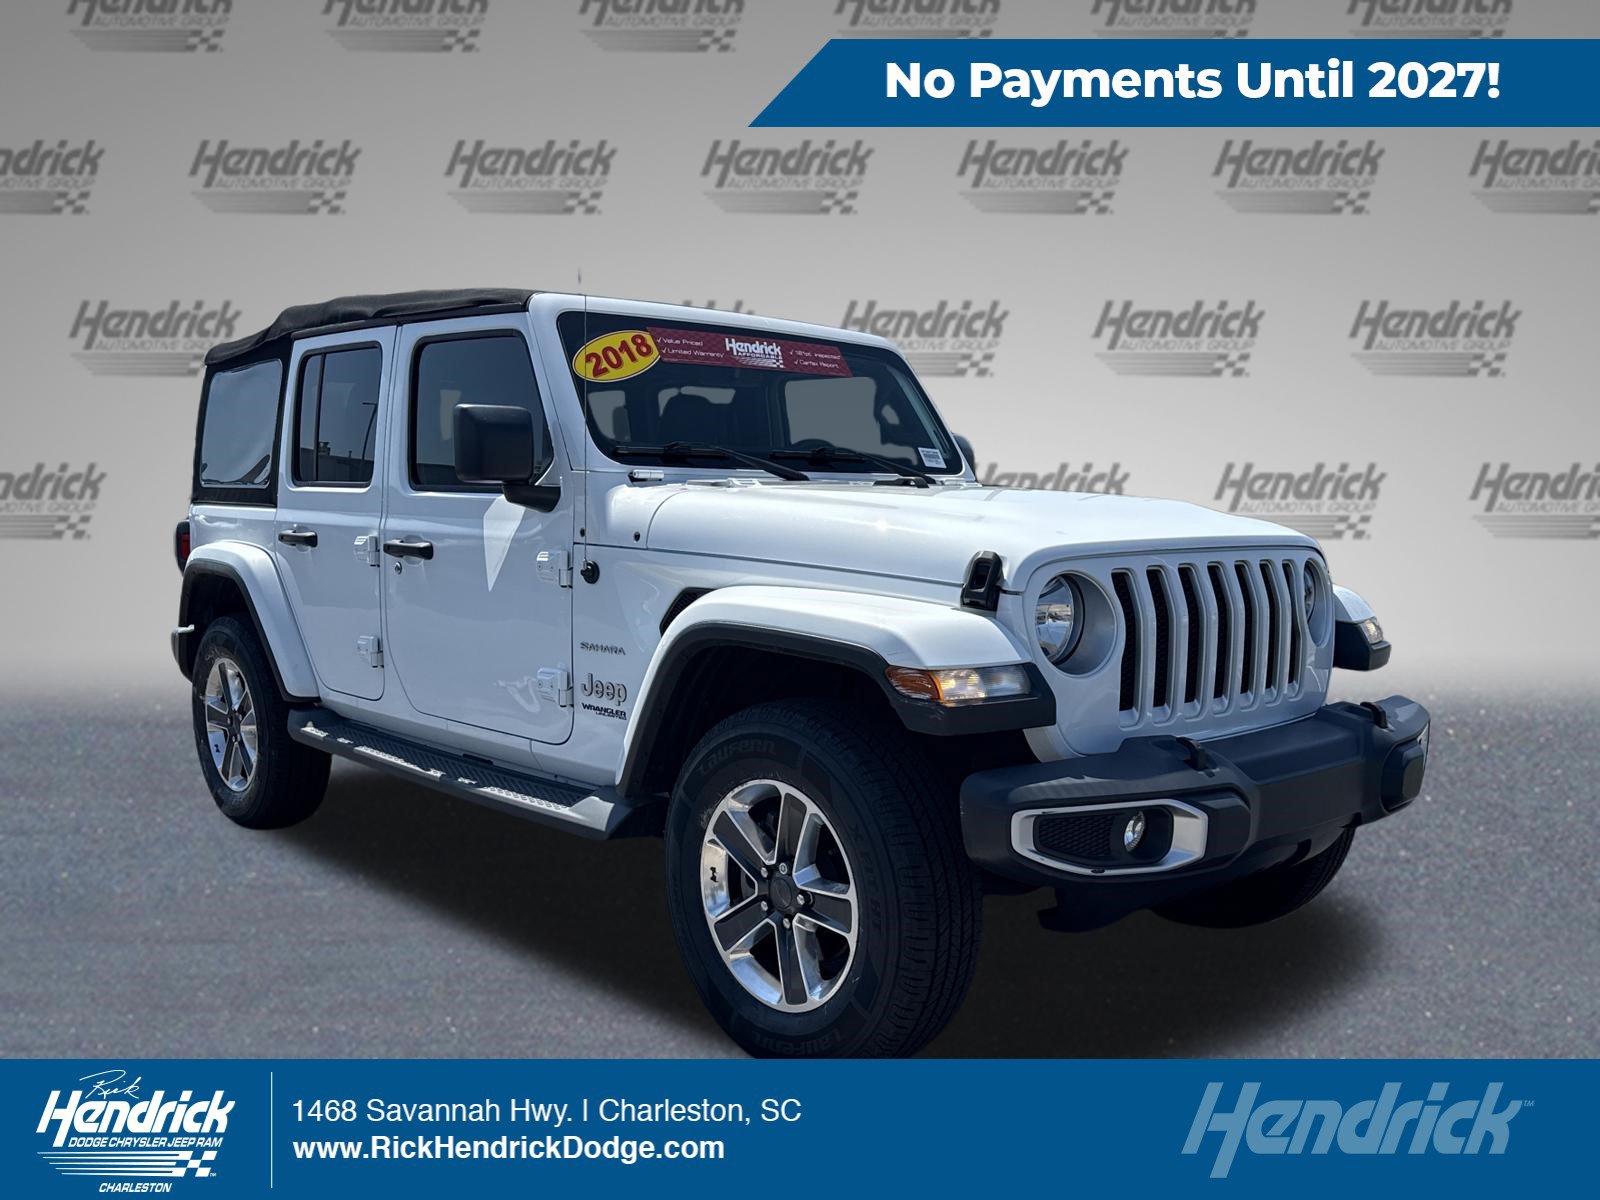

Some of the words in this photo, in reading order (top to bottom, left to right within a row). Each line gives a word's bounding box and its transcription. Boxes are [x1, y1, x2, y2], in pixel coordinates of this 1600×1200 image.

[585, 334, 653, 378] 2018
[724, 337, 782, 356] Hendrick
[580, 642, 626, 655] SAHARA
[581, 672, 628, 706] Jeep
[581, 702, 627, 718] WRANGLER
